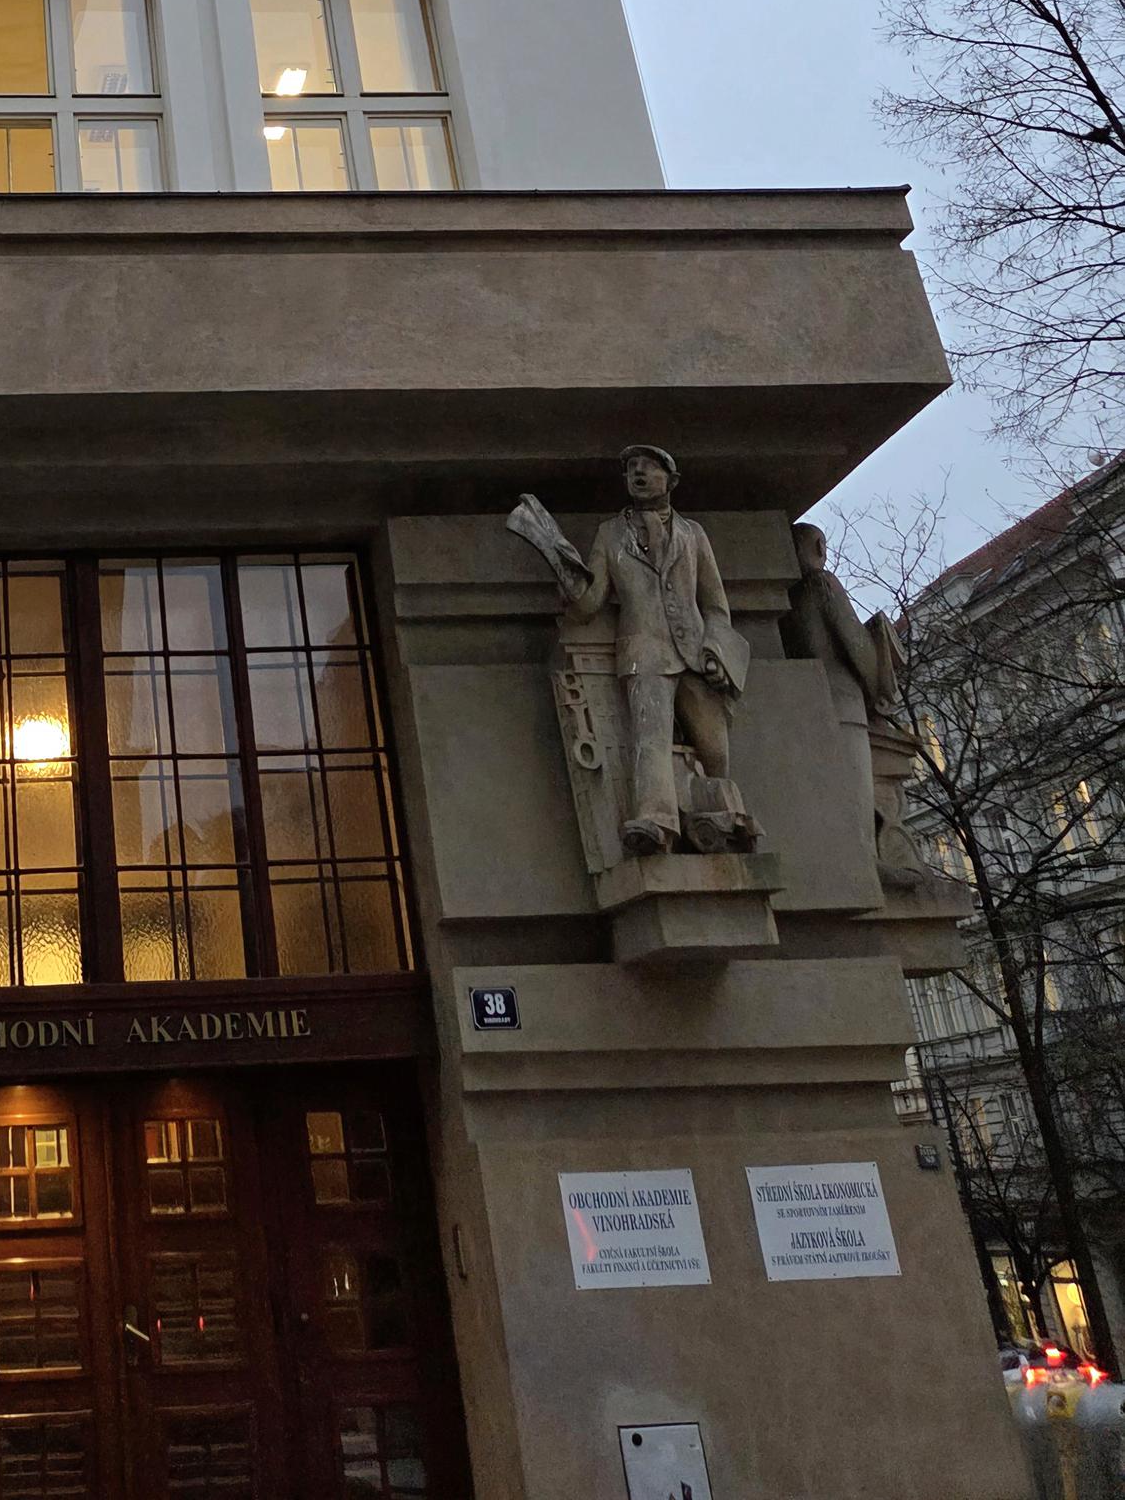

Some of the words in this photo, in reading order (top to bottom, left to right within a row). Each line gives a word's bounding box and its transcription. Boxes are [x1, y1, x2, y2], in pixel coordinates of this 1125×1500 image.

[557, 670, 600, 770] BIO
[484, 993, 506, 1015] 38
[126, 1008, 311, 1044] AKADEMIE
[568, 1186, 629, 1209] OBCHODNÍ
[632, 1188, 692, 1207] AKADEMIE
[756, 1181, 793, 1202] STŘEDNÍ
[793, 1180, 822, 1200] ŠKOLA
[822, 1178, 878, 1199] EKONOMICKÁ
[592, 1208, 675, 1232] VINOHRADSKÁ
[776, 1208, 786, 1218] SE
[786, 1205, 828, 1218] SPORTOVNÍM
[828, 1203, 866, 1216] ZAMĚŘENÍM
[790, 1226, 836, 1249] JAZYKOVÁ
[836, 1227, 866, 1248] ŠKOLA
[657, 1244, 680, 1258] ŠKOLA
[777, 1252, 804, 1266] PRÁVEM
[804, 1251, 828, 1264] STÁTNÍ
[613, 1259, 640, 1272] FINANCÍ
